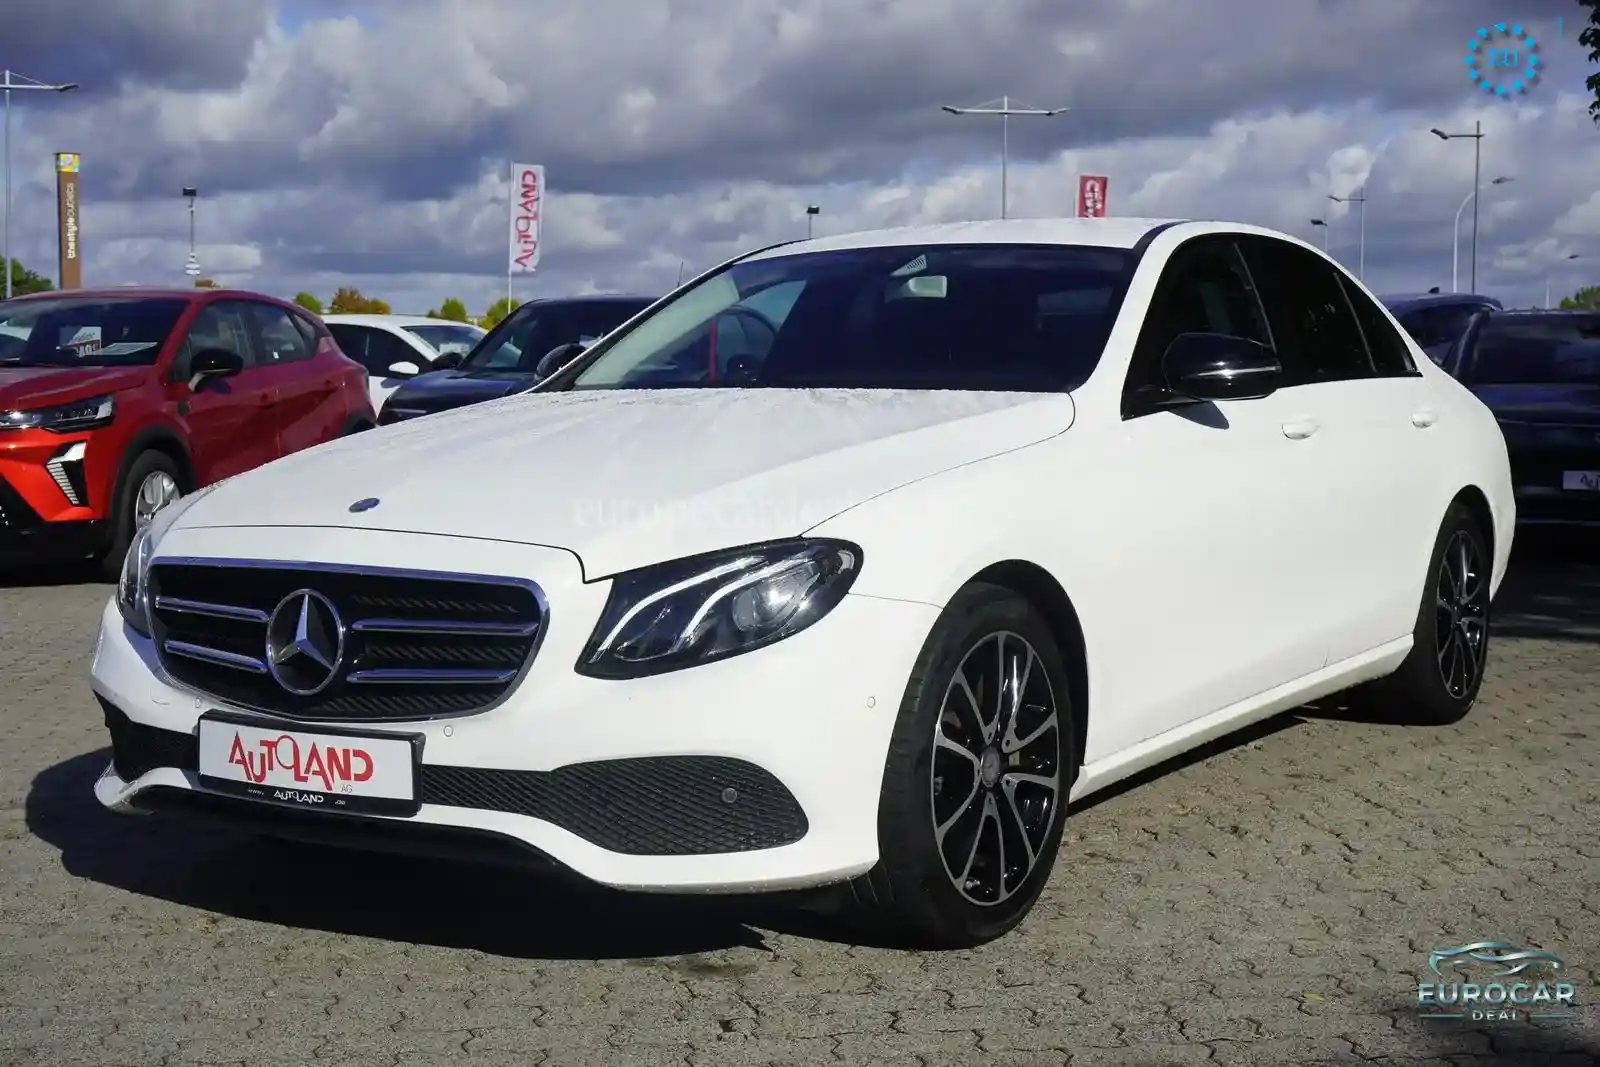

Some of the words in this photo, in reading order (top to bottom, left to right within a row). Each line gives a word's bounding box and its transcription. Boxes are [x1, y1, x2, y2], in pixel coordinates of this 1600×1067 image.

[514, 170, 539, 268] AUTOLAND
[228, 731, 374, 791] AUTOLAND
[273, 789, 324, 804] AUTOLAND
[340, 784, 353, 793] AG
